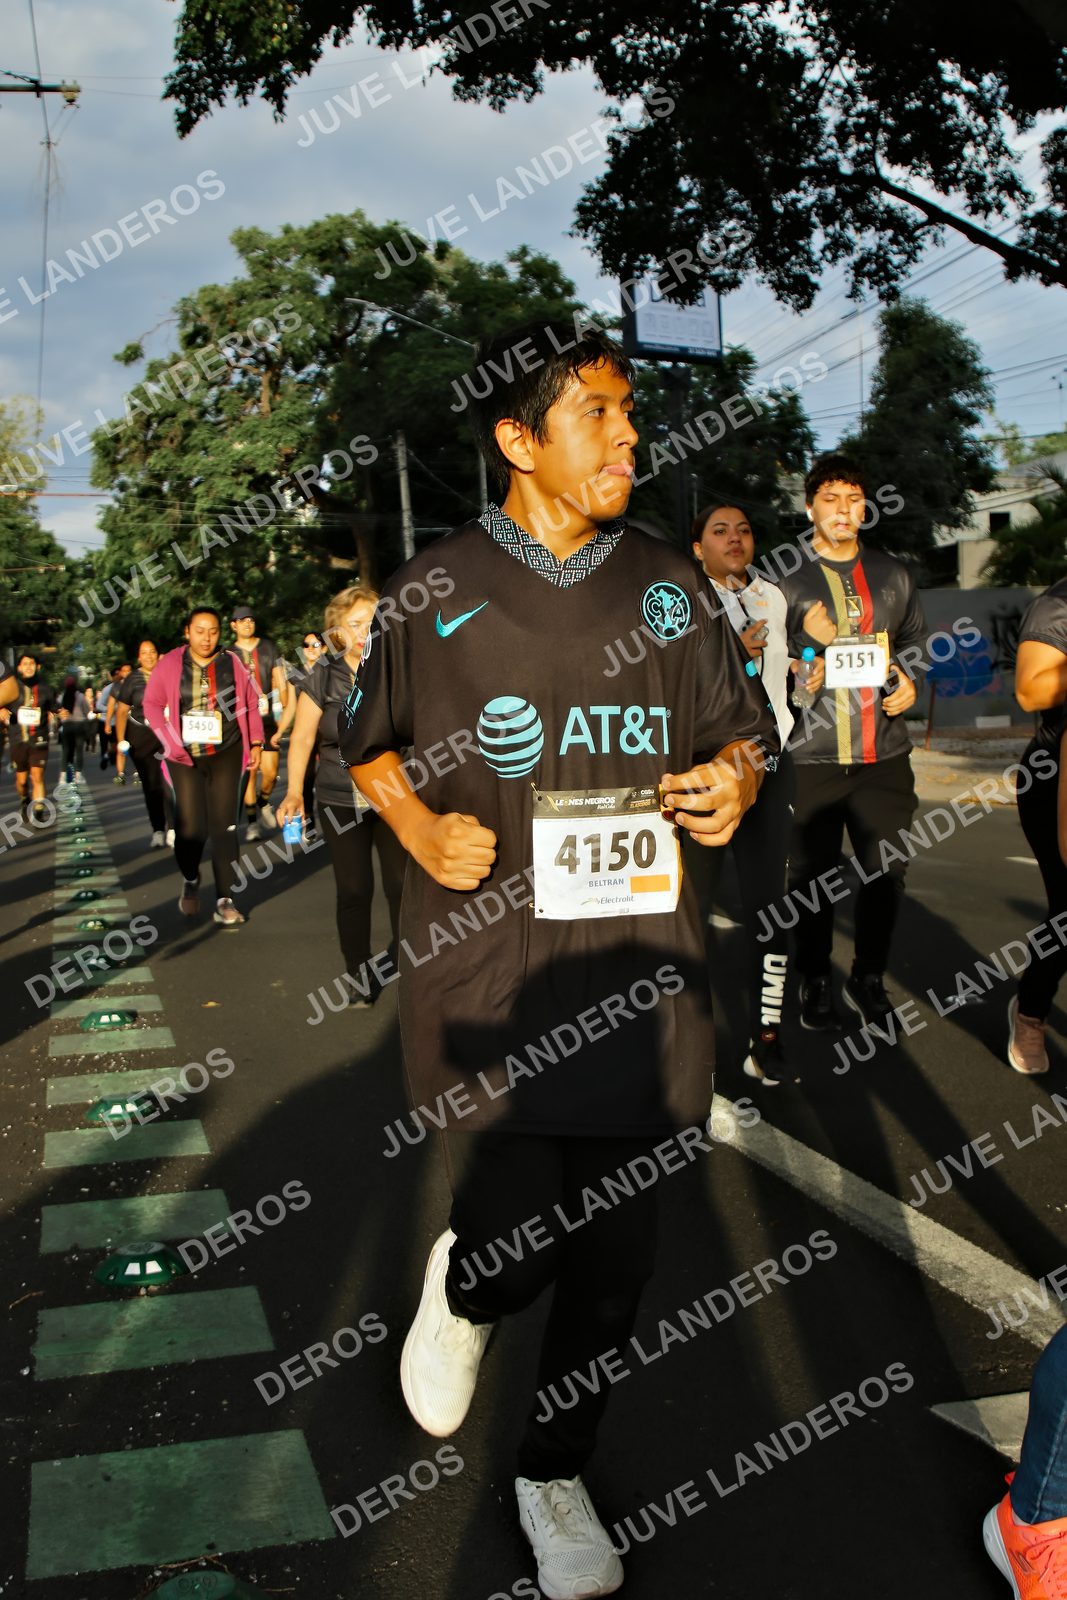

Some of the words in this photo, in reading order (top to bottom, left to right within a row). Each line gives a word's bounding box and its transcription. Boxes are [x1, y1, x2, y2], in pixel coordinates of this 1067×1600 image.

[835, 651, 875, 669] 5151
[188, 720, 214, 731] 5450
[559, 705, 670, 755] AT&T
[584, 796, 616, 805] NEGROS
[554, 829, 657, 875] 4150
[588, 878, 625, 888] BELTRAN
